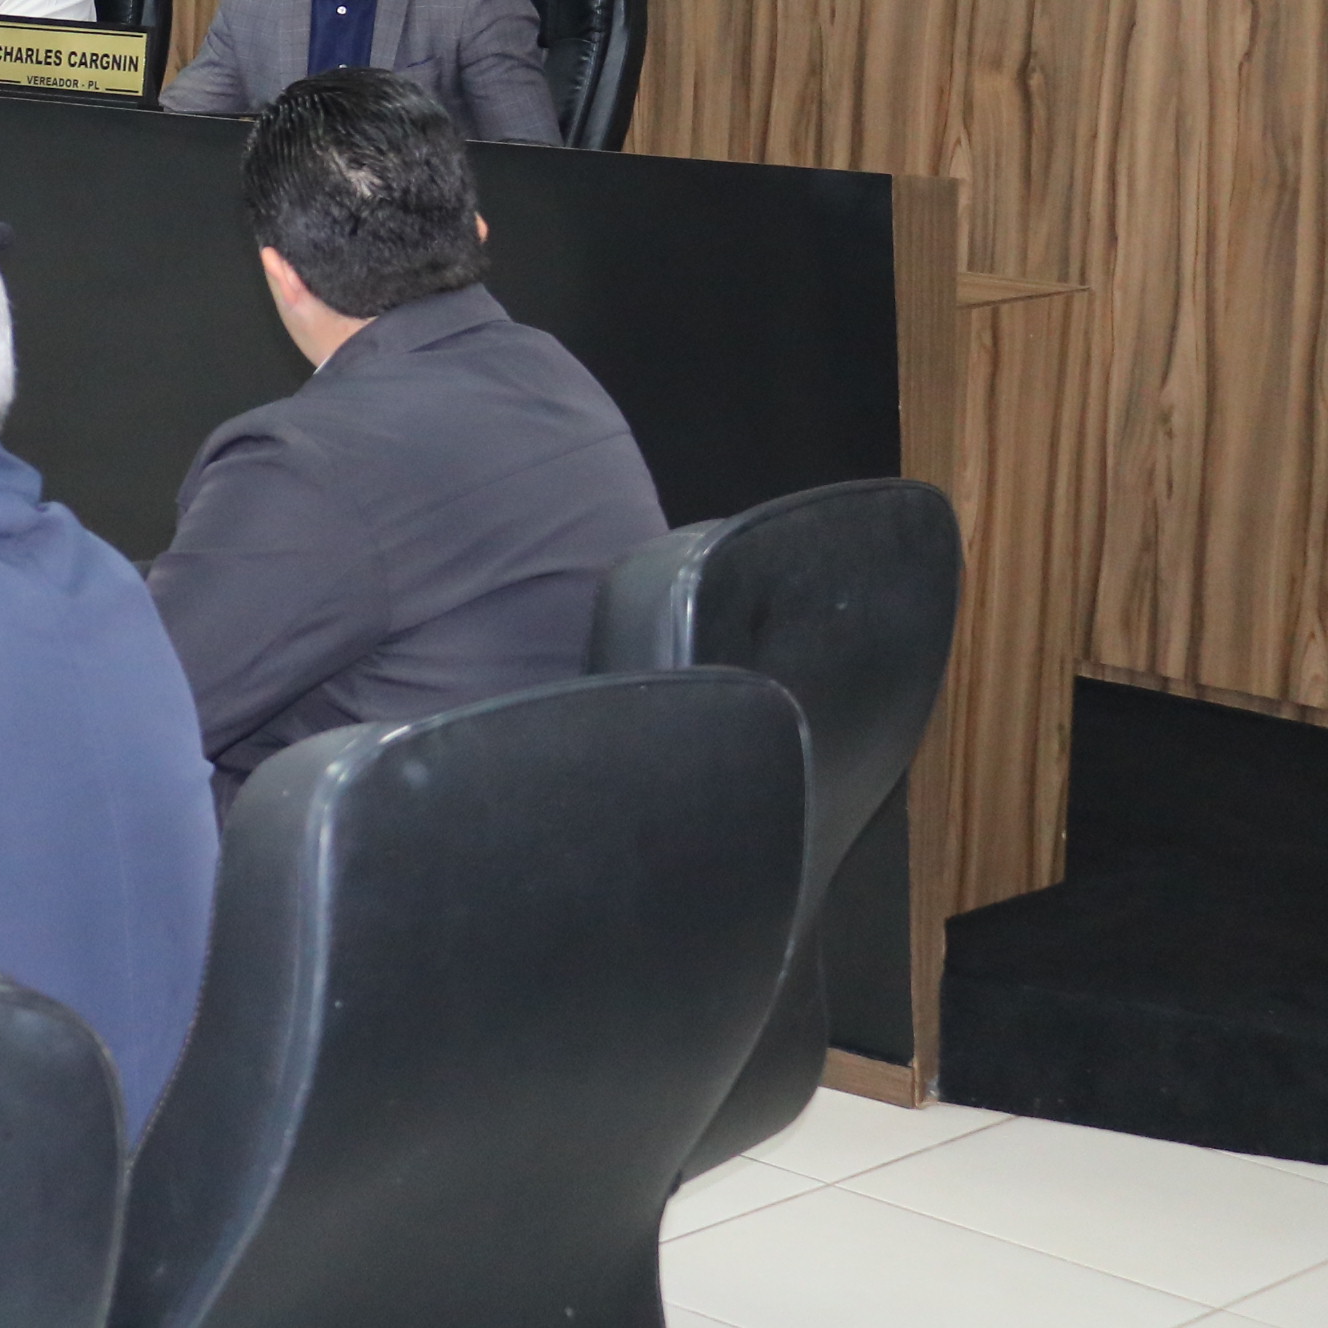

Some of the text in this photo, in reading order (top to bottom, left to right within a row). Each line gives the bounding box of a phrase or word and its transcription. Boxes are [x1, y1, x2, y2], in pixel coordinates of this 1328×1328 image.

[67, 50, 139, 73] CARGNIN
[26, 75, 79, 89] VEREADOR
[87, 80, 100, 91] PL
